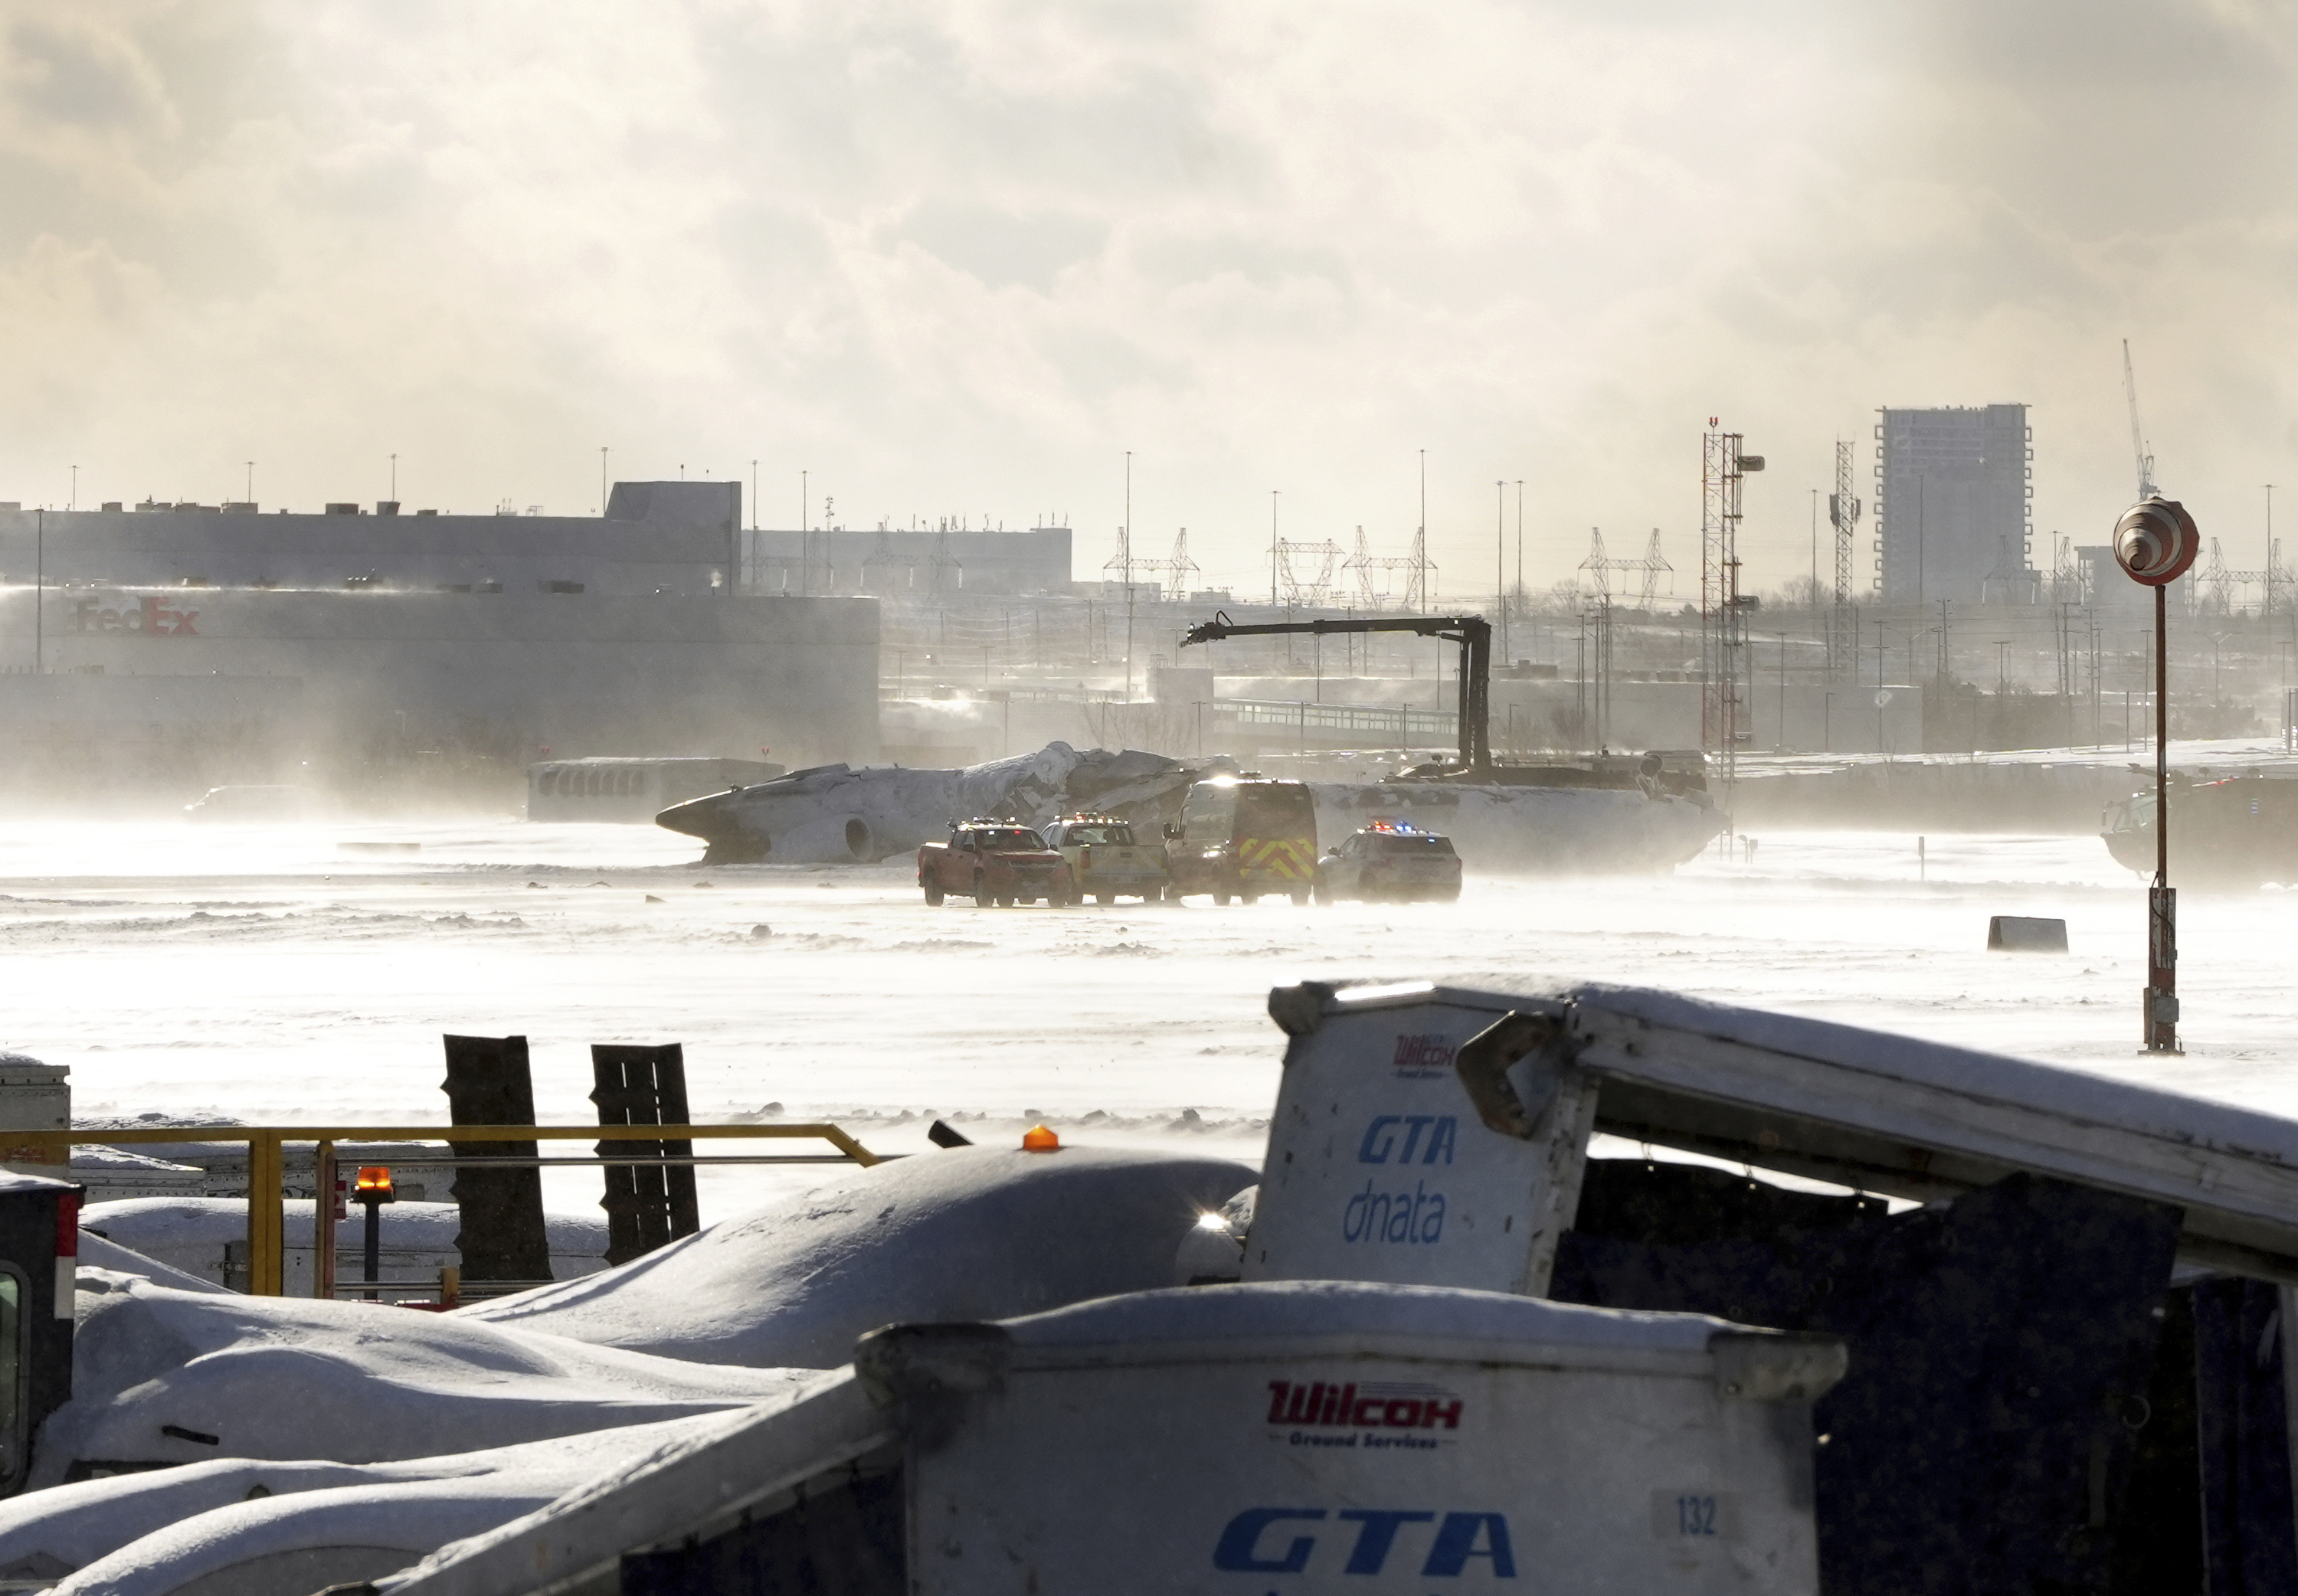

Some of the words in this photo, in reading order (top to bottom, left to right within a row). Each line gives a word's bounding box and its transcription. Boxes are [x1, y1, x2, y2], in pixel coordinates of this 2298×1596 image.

[76, 596, 201, 636] FedEx
[1394, 1034, 1455, 1065] Wilcox
[1358, 1115, 1457, 1165] GTA
[1344, 1179, 1446, 1244] dnata
[1268, 1381, 1463, 1428] Wilcox
[1289, 1431, 1357, 1447] Ground
[1363, 1433, 1438, 1448] Services
[1676, 1496, 1717, 1535] 132
[1213, 1507, 1517, 1578] GTA
